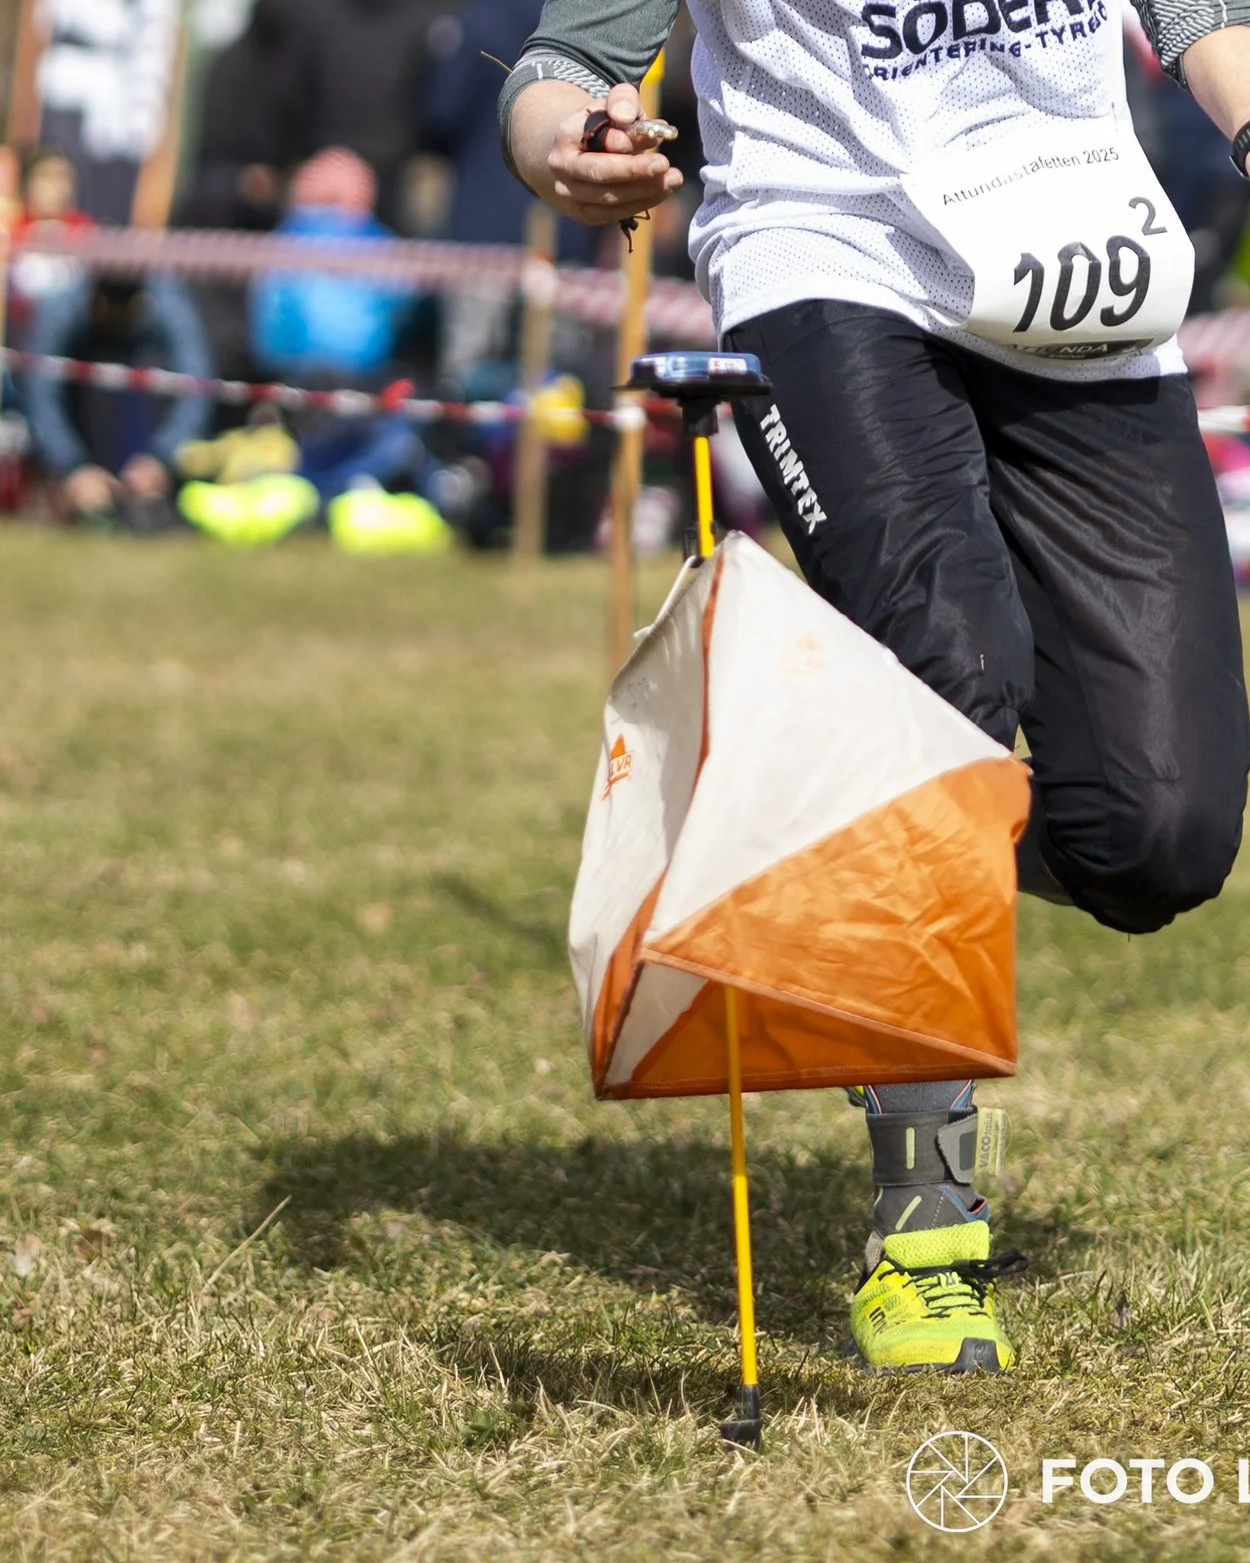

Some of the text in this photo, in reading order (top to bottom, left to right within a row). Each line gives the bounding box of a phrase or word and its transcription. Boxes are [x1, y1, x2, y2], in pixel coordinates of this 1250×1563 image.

[1082, 146, 1120, 164] 2025
[1128, 196, 1168, 236] 2
[1012, 235, 1151, 333] 109
